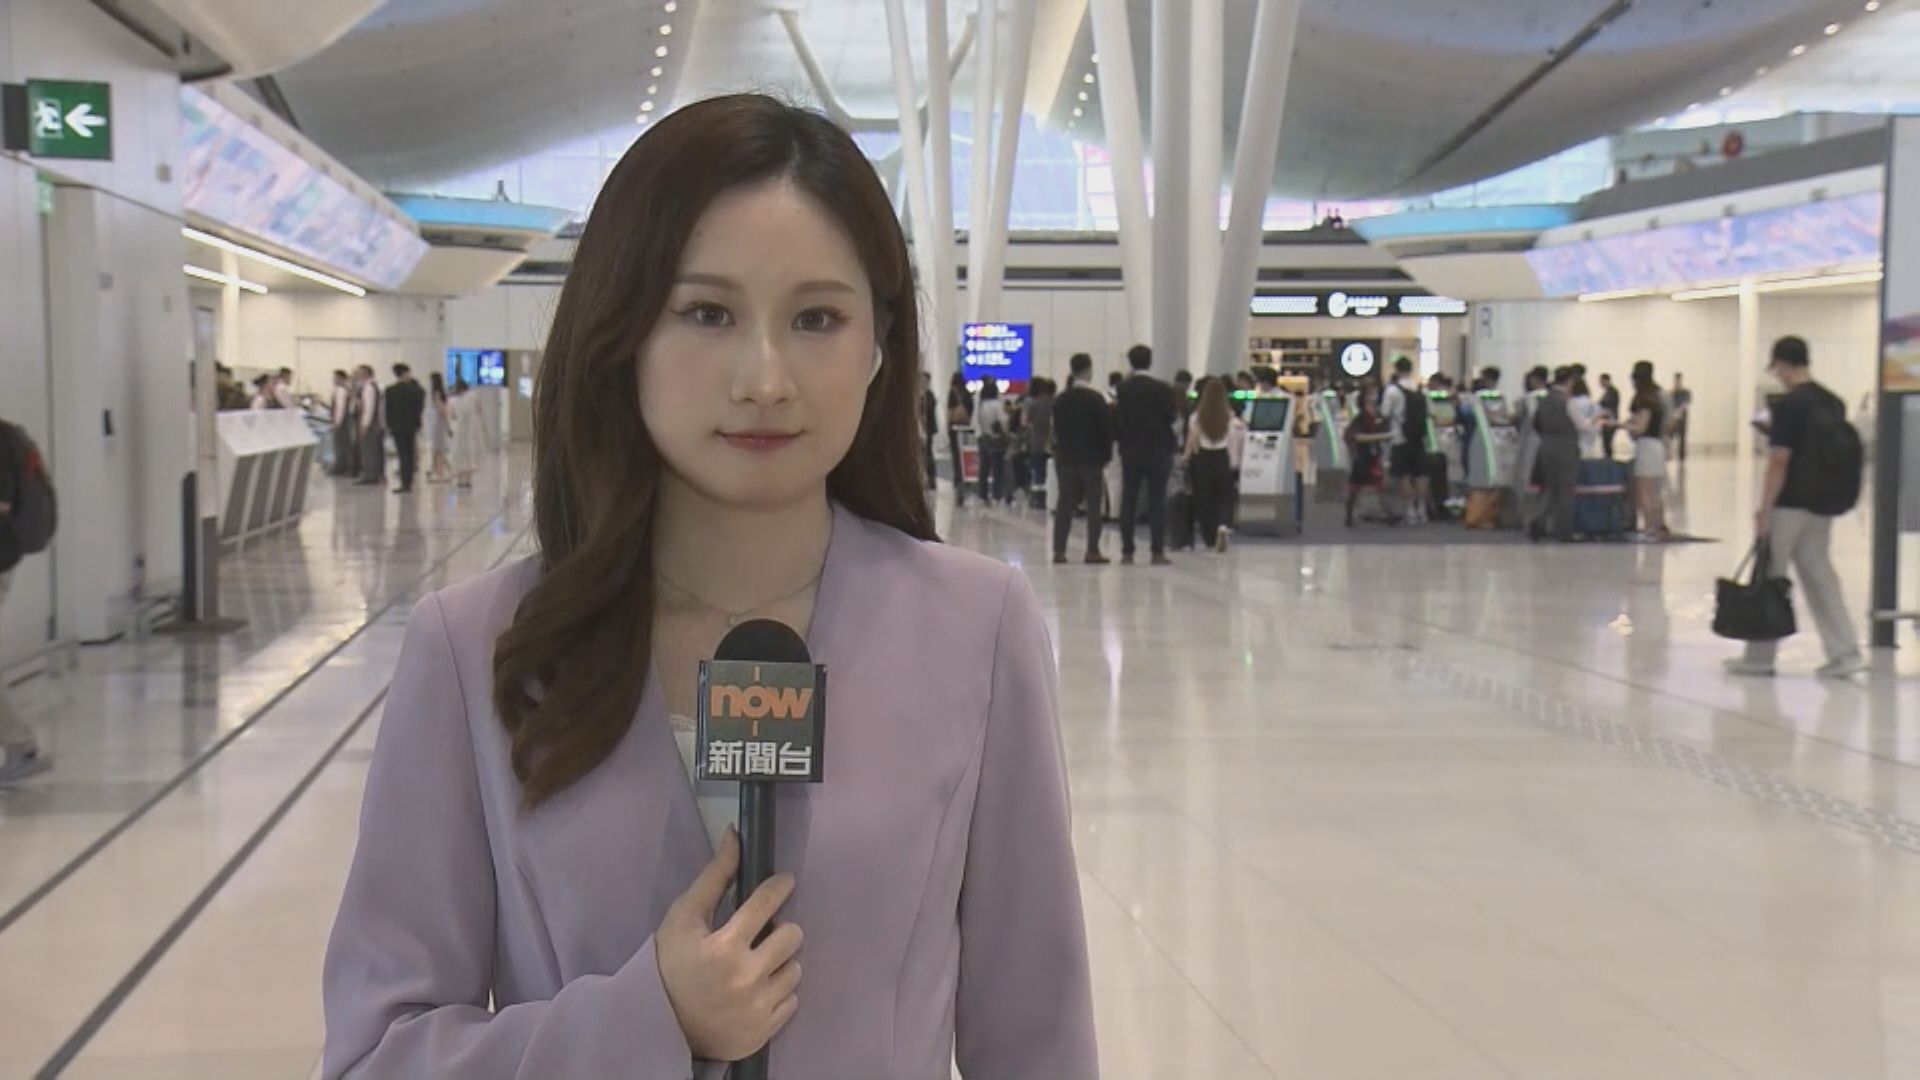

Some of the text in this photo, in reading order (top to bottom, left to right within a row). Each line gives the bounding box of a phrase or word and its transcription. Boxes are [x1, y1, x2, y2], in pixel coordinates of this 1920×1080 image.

[710, 684, 814, 719] now
[708, 740, 812, 775] 新聞台
